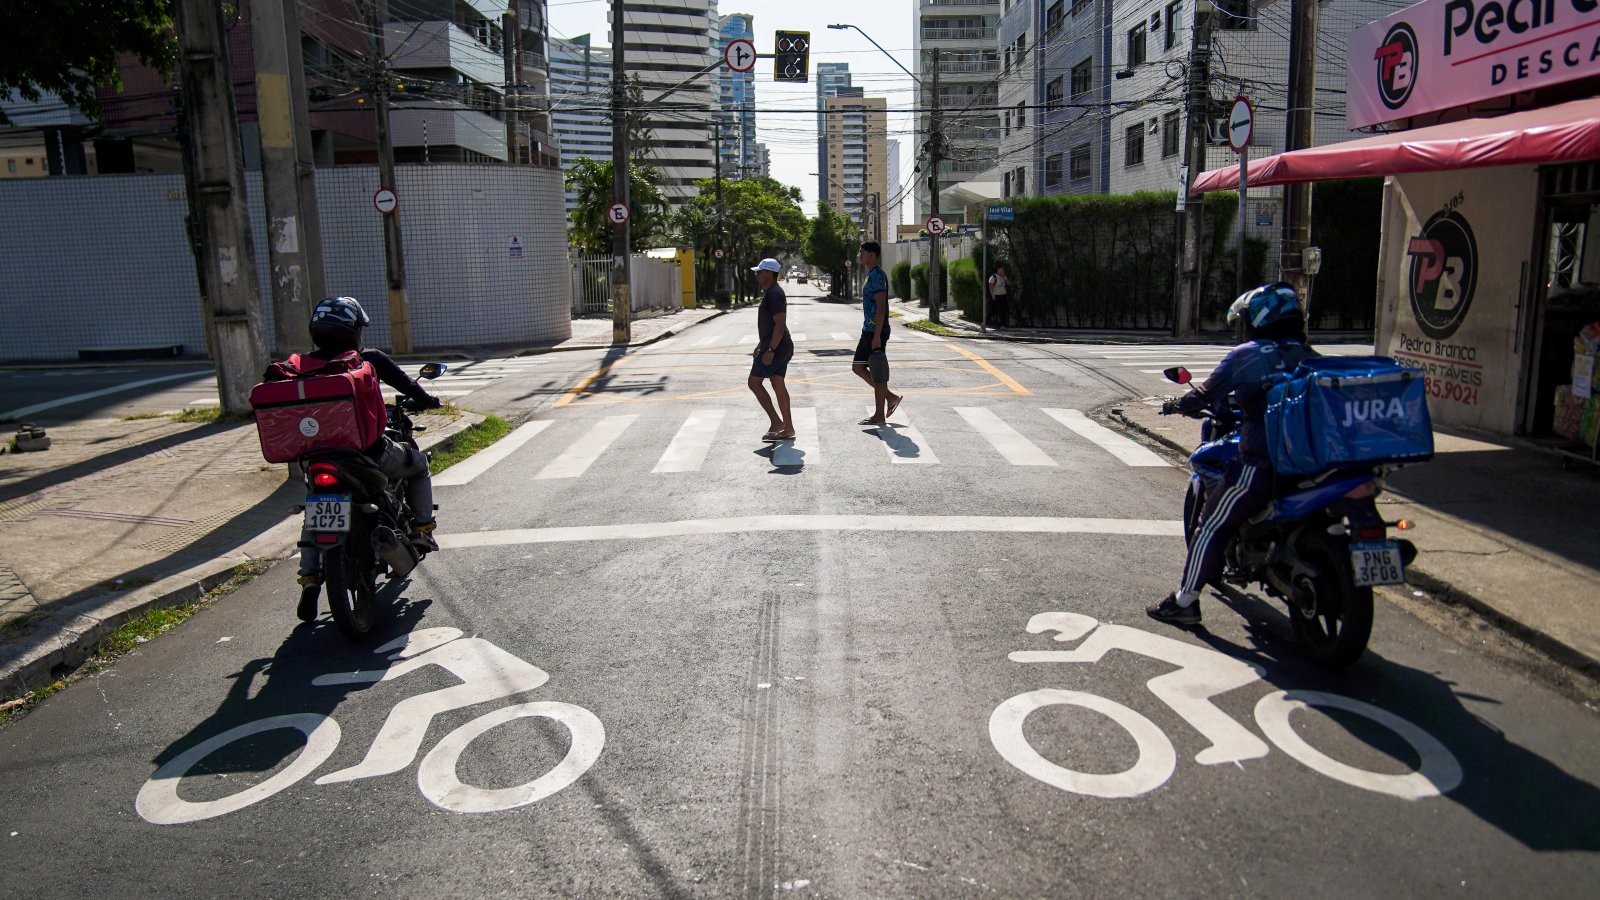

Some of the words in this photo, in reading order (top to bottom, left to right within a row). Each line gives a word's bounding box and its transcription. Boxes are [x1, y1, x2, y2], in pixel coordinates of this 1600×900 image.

[1400, 333, 1431, 354] Pedra
[1435, 341, 1476, 362] Branca
[1342, 397, 1405, 428] JURA
[311, 515, 346, 528] 1C75
[1363, 550, 1391, 566] PNG
[1360, 566, 1398, 582] 3F08
